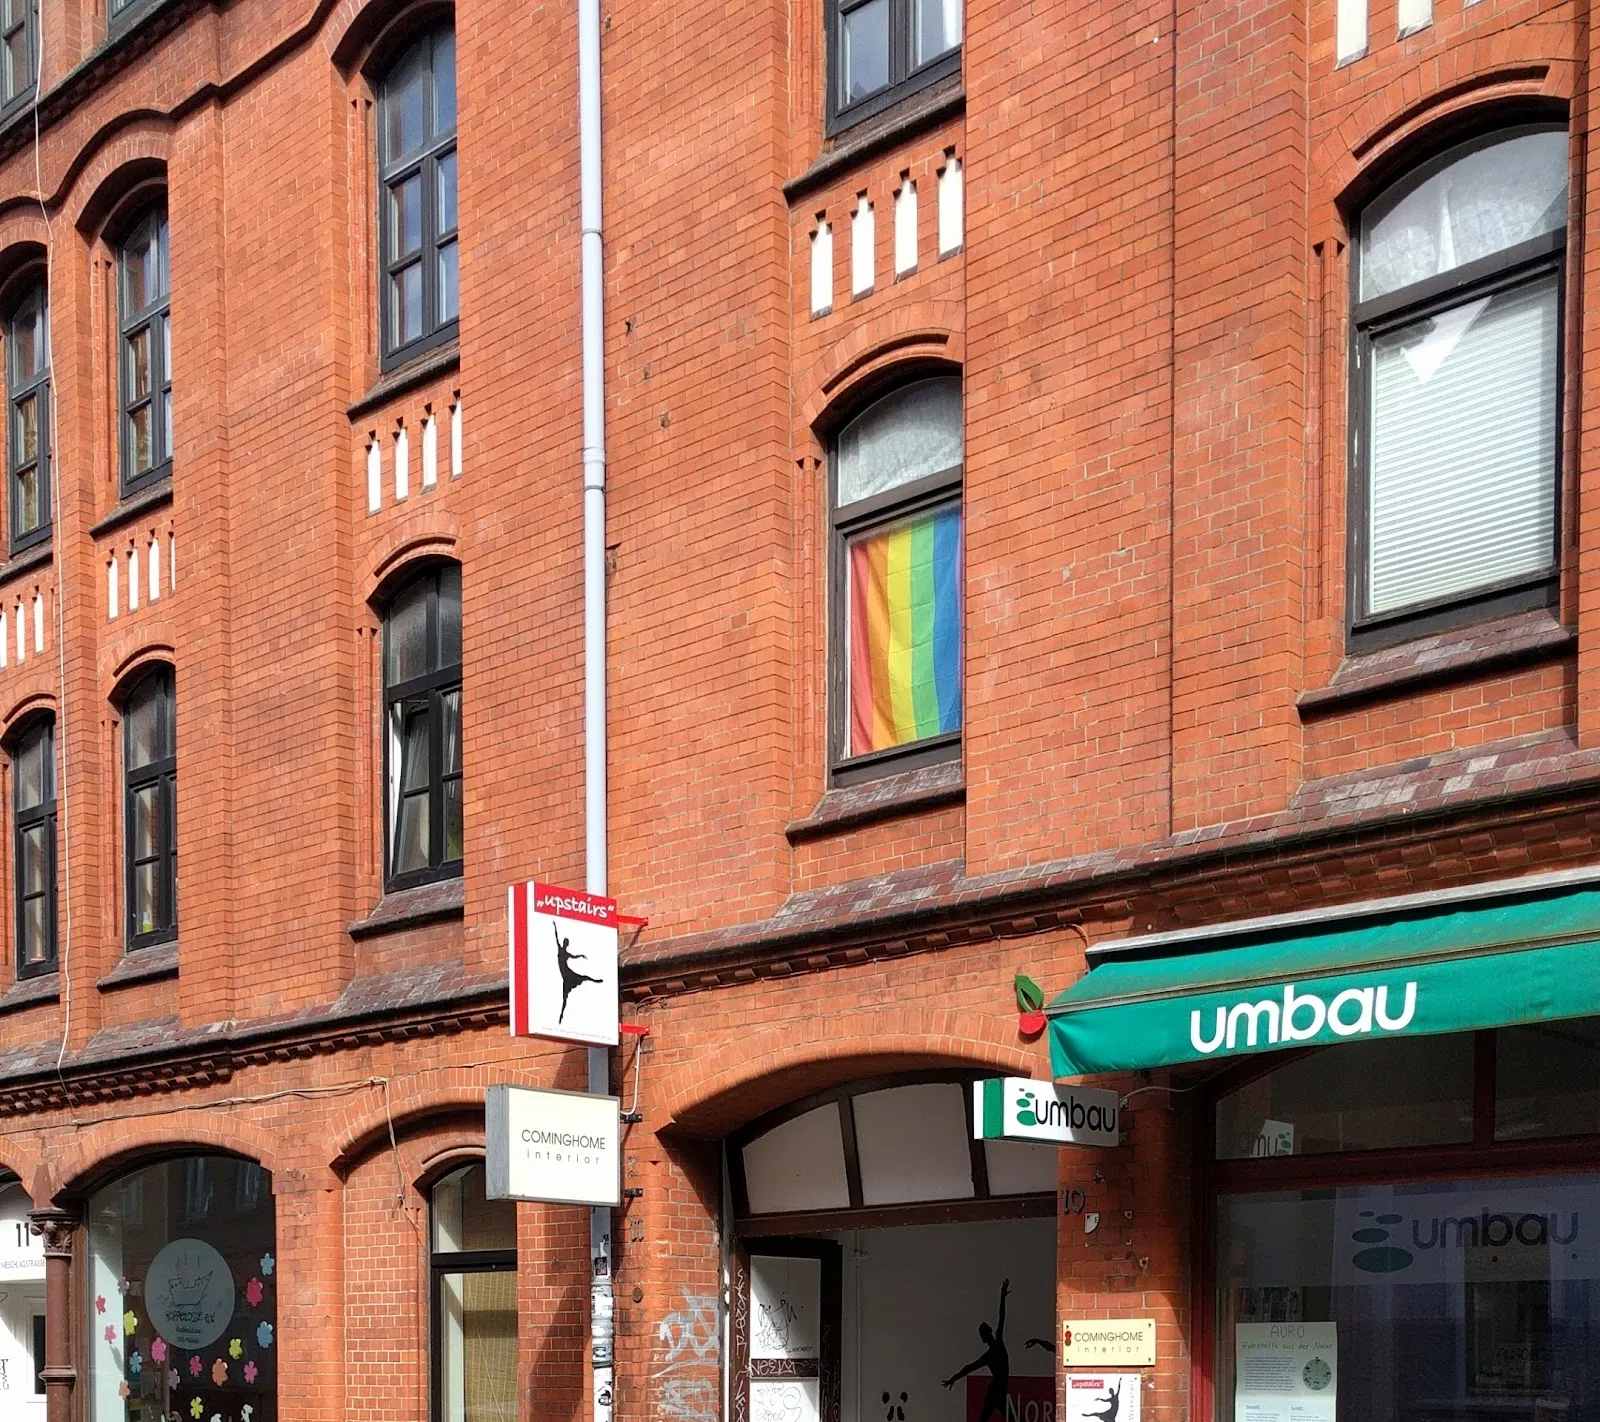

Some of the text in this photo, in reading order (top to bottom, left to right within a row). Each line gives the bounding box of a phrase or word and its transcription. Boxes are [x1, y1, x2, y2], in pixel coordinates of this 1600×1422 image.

[1190, 982, 1417, 1054] umbau
[1034, 1096, 1116, 1133] umbau
[521, 1129, 606, 1150] COMINGHOME
[526, 1149, 601, 1165] interior
[1062, 1187, 1086, 1215] 10
[16, 1222, 30, 1247] 11
[1412, 1207, 1580, 1250] umbau
[1074, 1332, 1143, 1342] COMINGHOME
[1270, 1325, 1305, 1338] AURO
